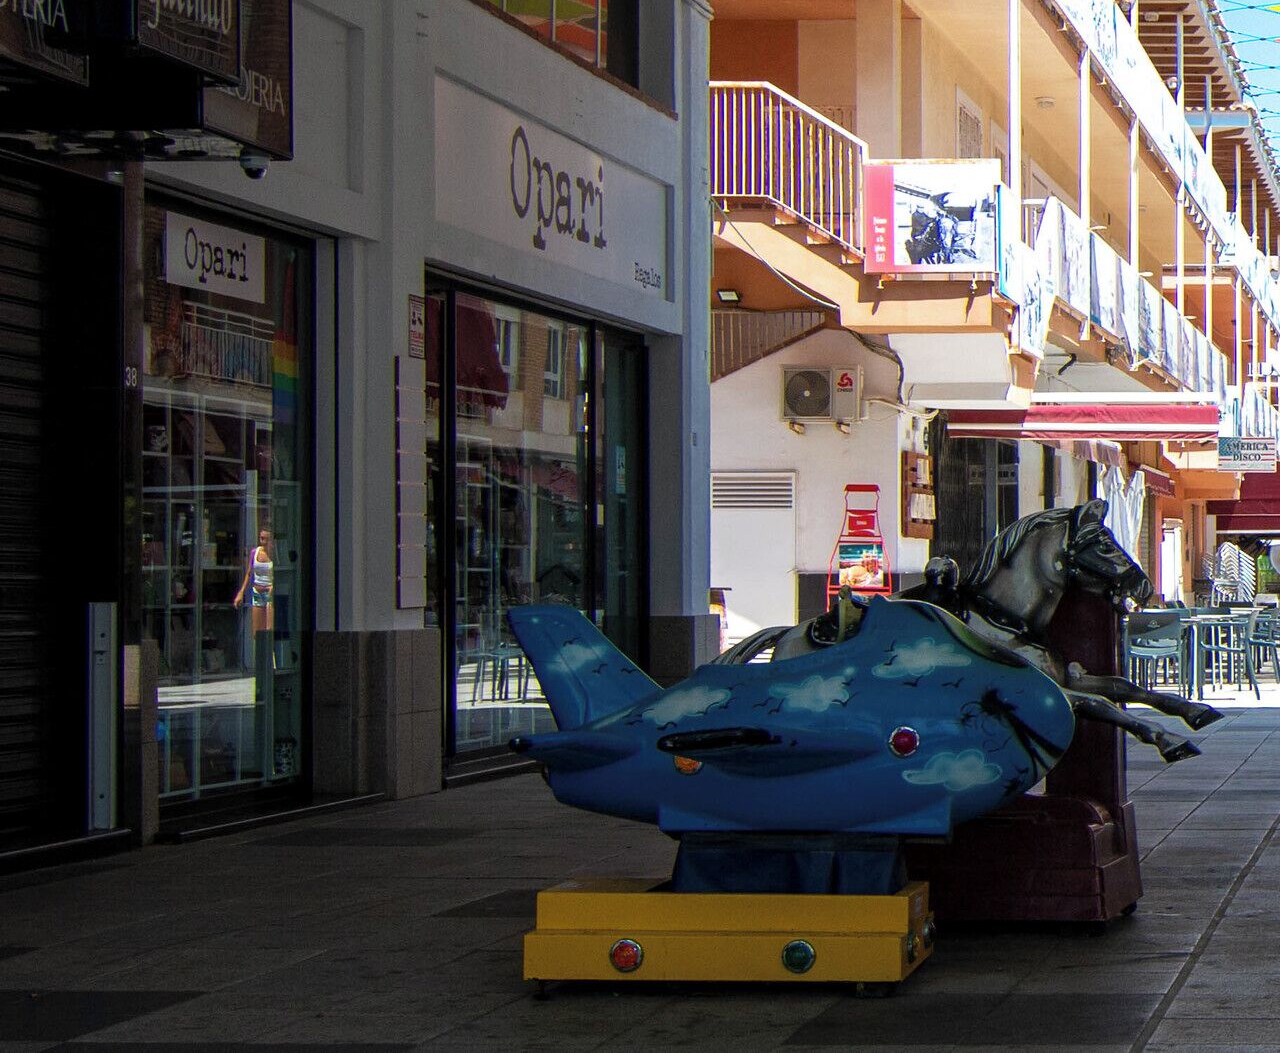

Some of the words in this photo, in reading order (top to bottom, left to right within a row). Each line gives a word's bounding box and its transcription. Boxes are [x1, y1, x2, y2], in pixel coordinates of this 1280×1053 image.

[510, 124, 608, 251] Opari
[184, 226, 249, 284] Opari
[125, 366, 138, 387] 38
[1226, 442, 1269, 451] AMERICA
[1232, 453, 1262, 462] DISCO
